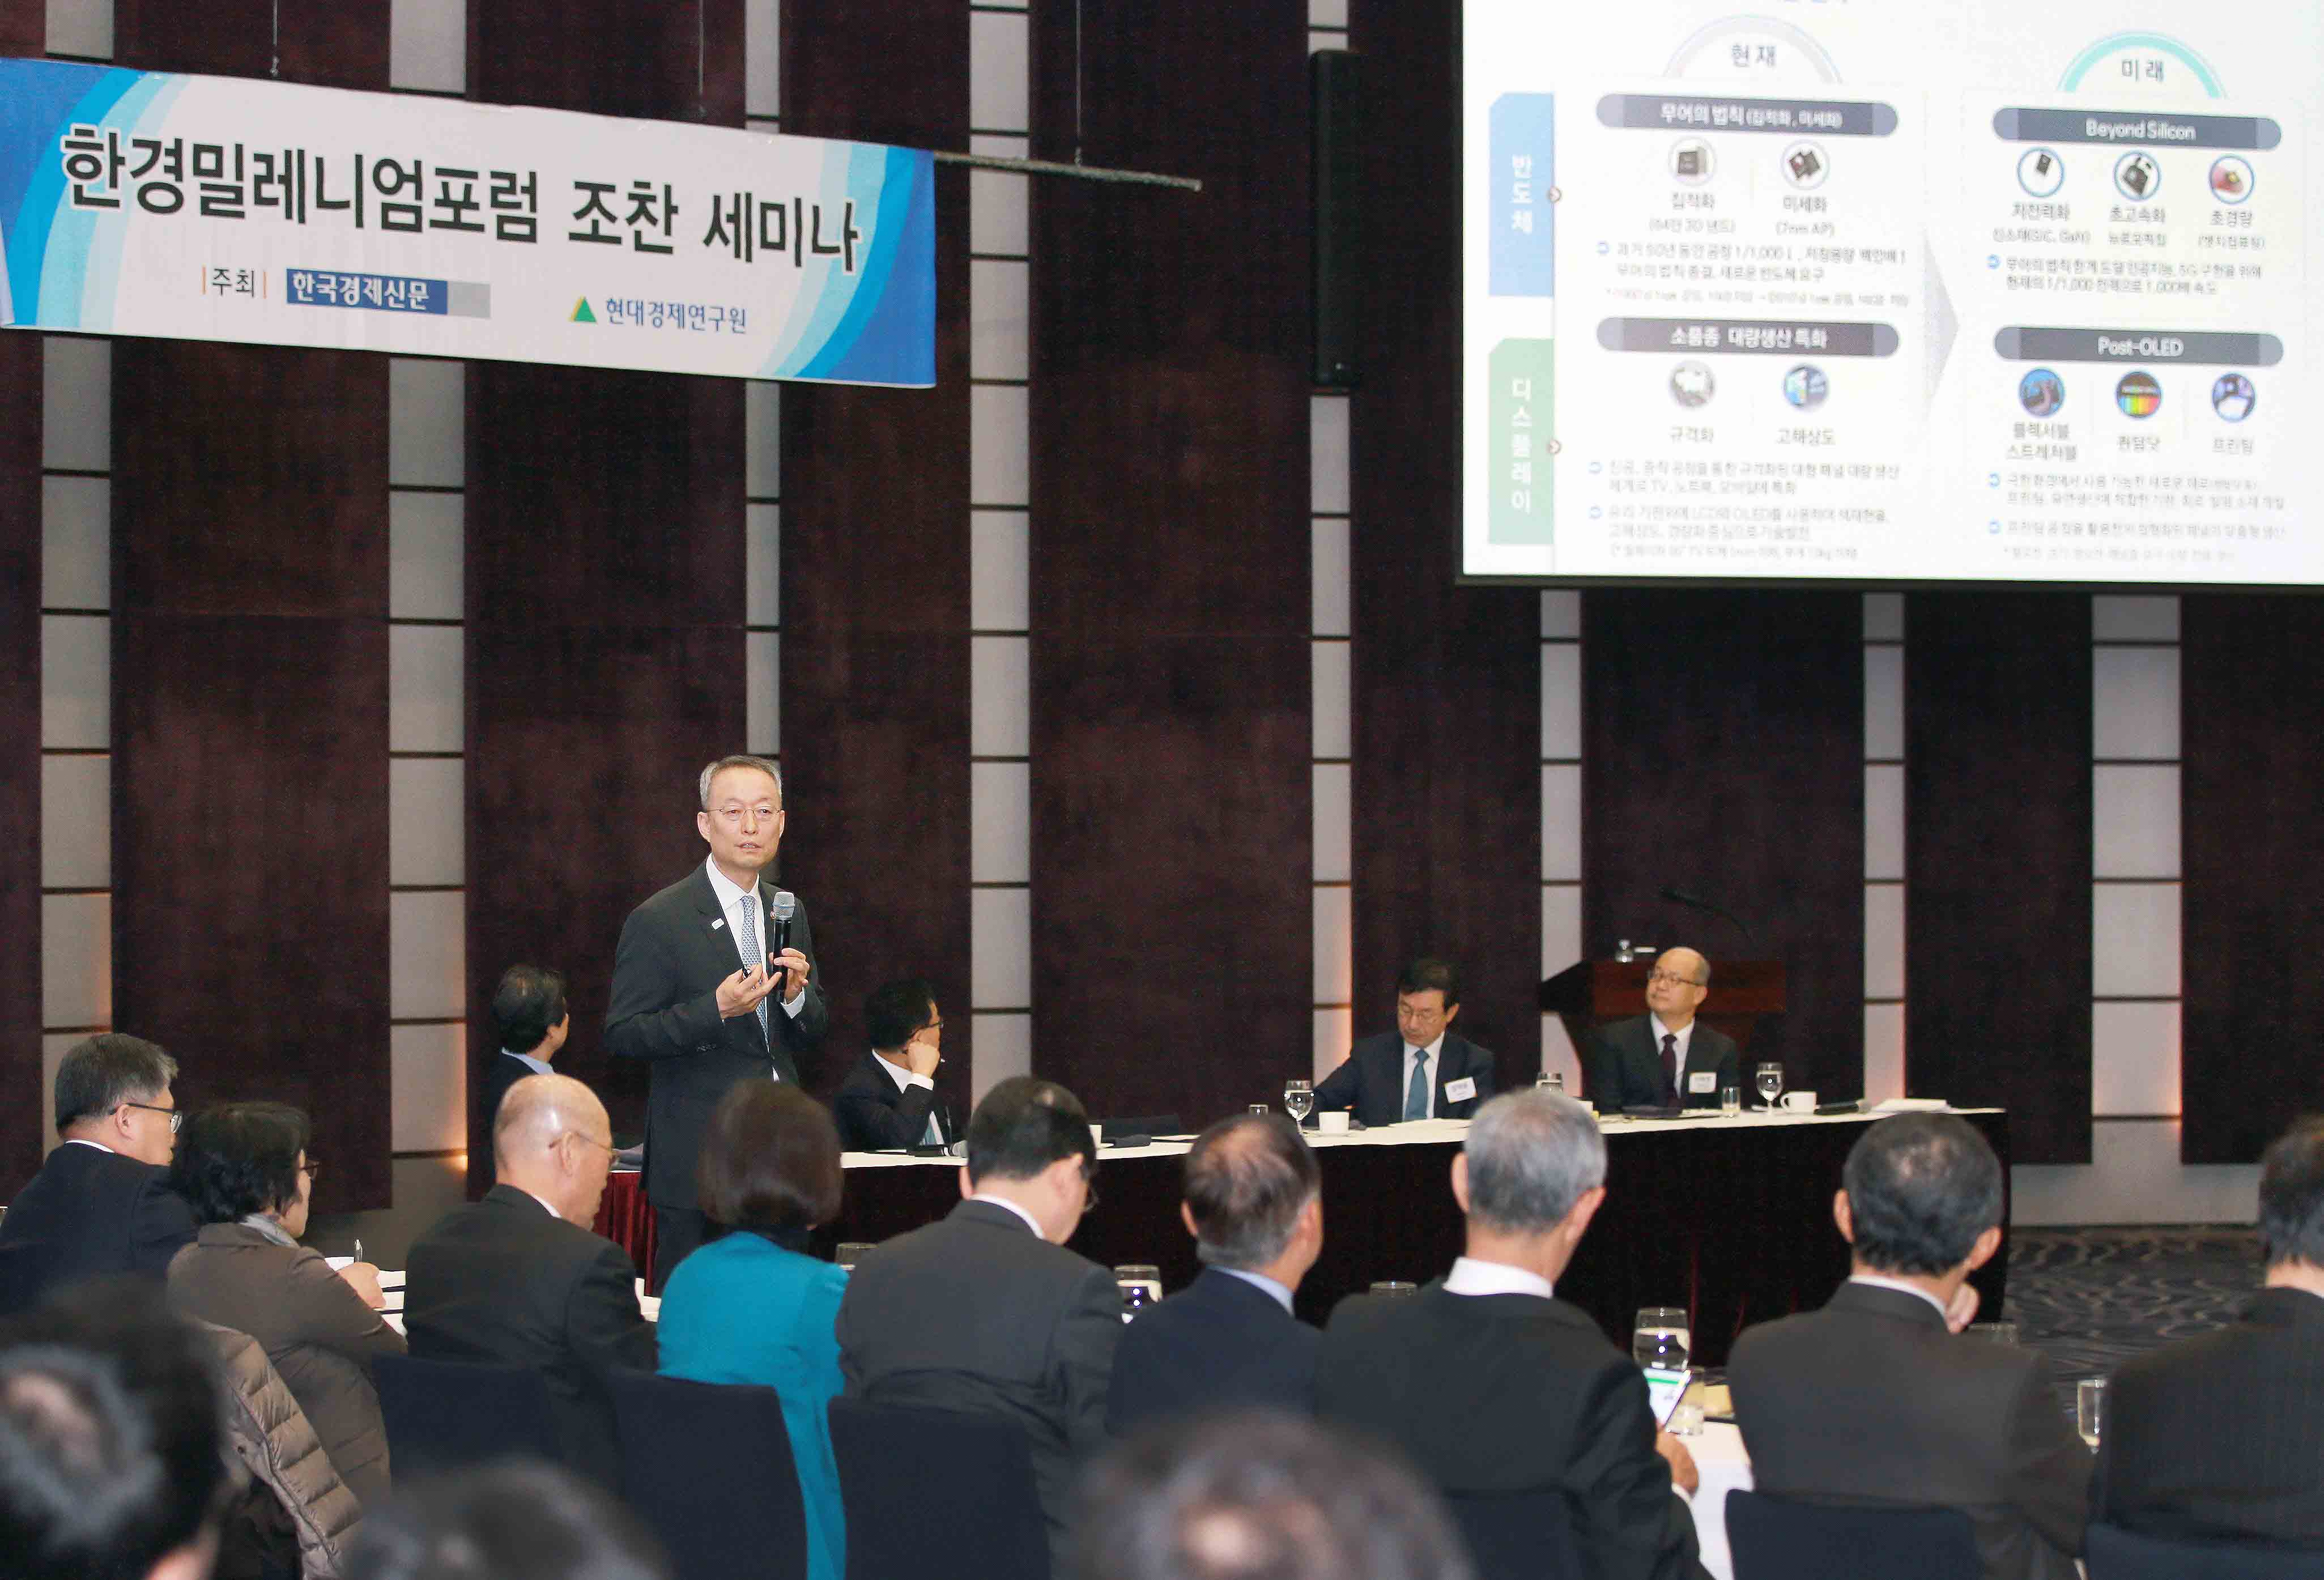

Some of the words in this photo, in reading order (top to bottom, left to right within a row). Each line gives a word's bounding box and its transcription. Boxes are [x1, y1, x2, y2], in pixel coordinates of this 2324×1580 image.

[2085, 118, 2146, 140] Beyond
[2147, 120, 2197, 140] Silicon
[65, 127, 538, 244] 한경밀레니엄포럼
[568, 180, 679, 256] 조찬
[703, 191, 859, 272] 세미나
[211, 267, 256, 299] 주최
[293, 271, 430, 311] 한국경제신문
[606, 297, 747, 334] 현대경제연구원
[2097, 335, 2184, 357] Post-OLED
[1511, 377, 1533, 514] 디스플레이
